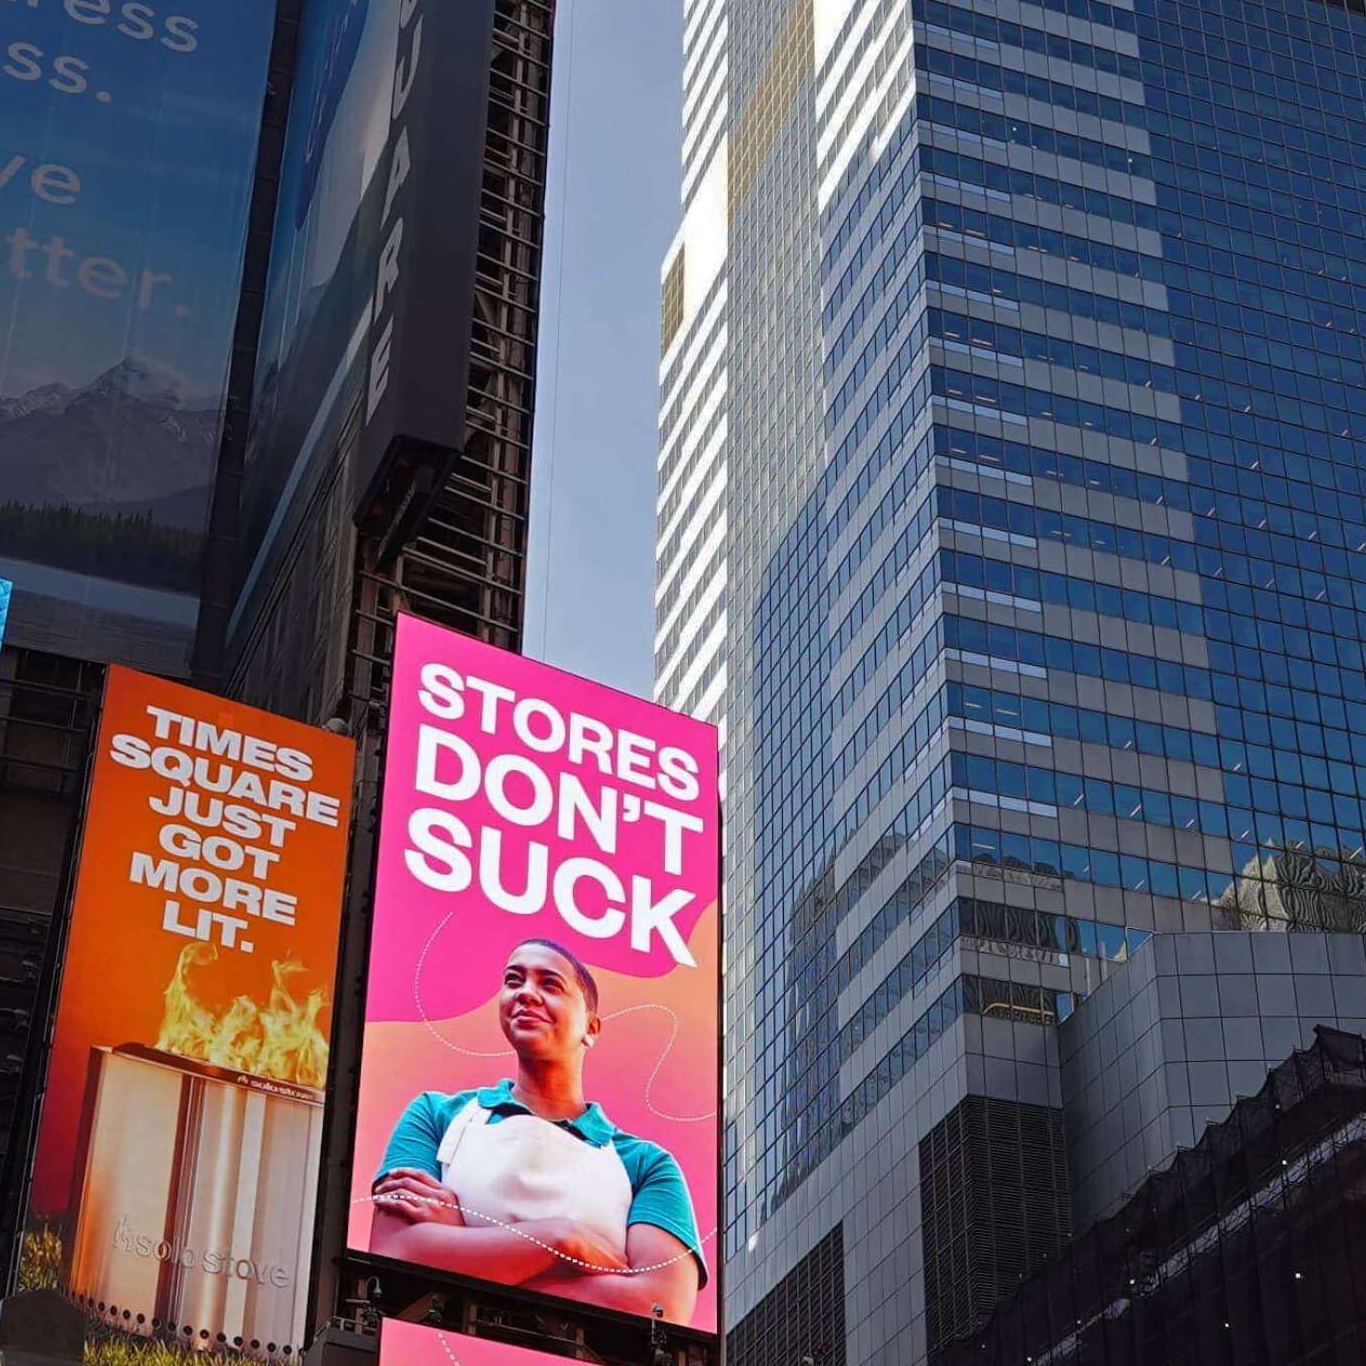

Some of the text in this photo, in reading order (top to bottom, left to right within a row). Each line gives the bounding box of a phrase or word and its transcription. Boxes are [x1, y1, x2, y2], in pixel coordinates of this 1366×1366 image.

[145, 705, 314, 782] TIMES
[418, 661, 700, 803] STORES
[111, 735, 340, 828] SQUARE
[149, 784, 297, 848] JUST
[416, 722, 704, 877] DON'T
[129, 852, 298, 926] MORE
[159, 823, 281, 881] GOT
[404, 807, 698, 970] SUCK
[163, 899, 255, 954] LIT.
[135, 1235, 290, 1289] solo stove
